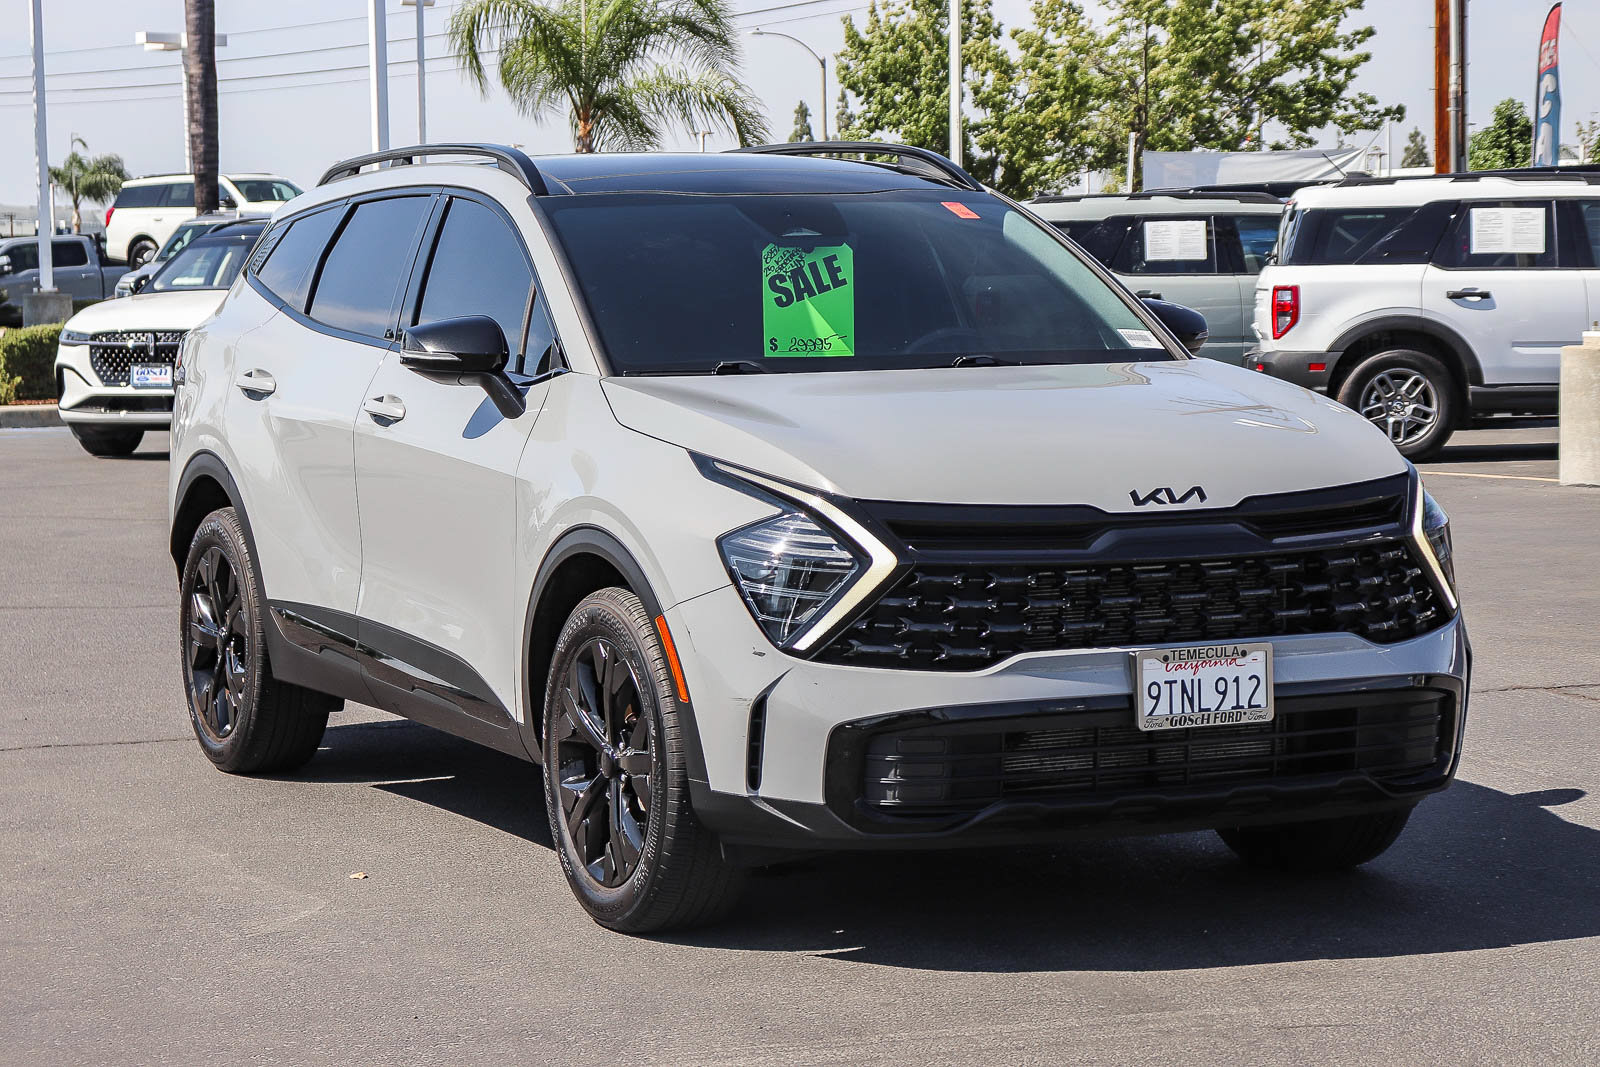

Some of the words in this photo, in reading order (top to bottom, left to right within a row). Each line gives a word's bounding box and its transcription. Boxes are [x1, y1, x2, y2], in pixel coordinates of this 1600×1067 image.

[768, 254, 848, 308] SALE
[769, 337, 778, 352] $
[1129, 486, 1208, 506] KIA
[1170, 646, 1240, 661] TEMECULA
[1165, 658, 1246, 676] California
[1147, 674, 1262, 716] 9TNL912
[1144, 718, 1164, 729] Ford
[1213, 711, 1242, 724] FORD
[1248, 710, 1268, 720] Ford
